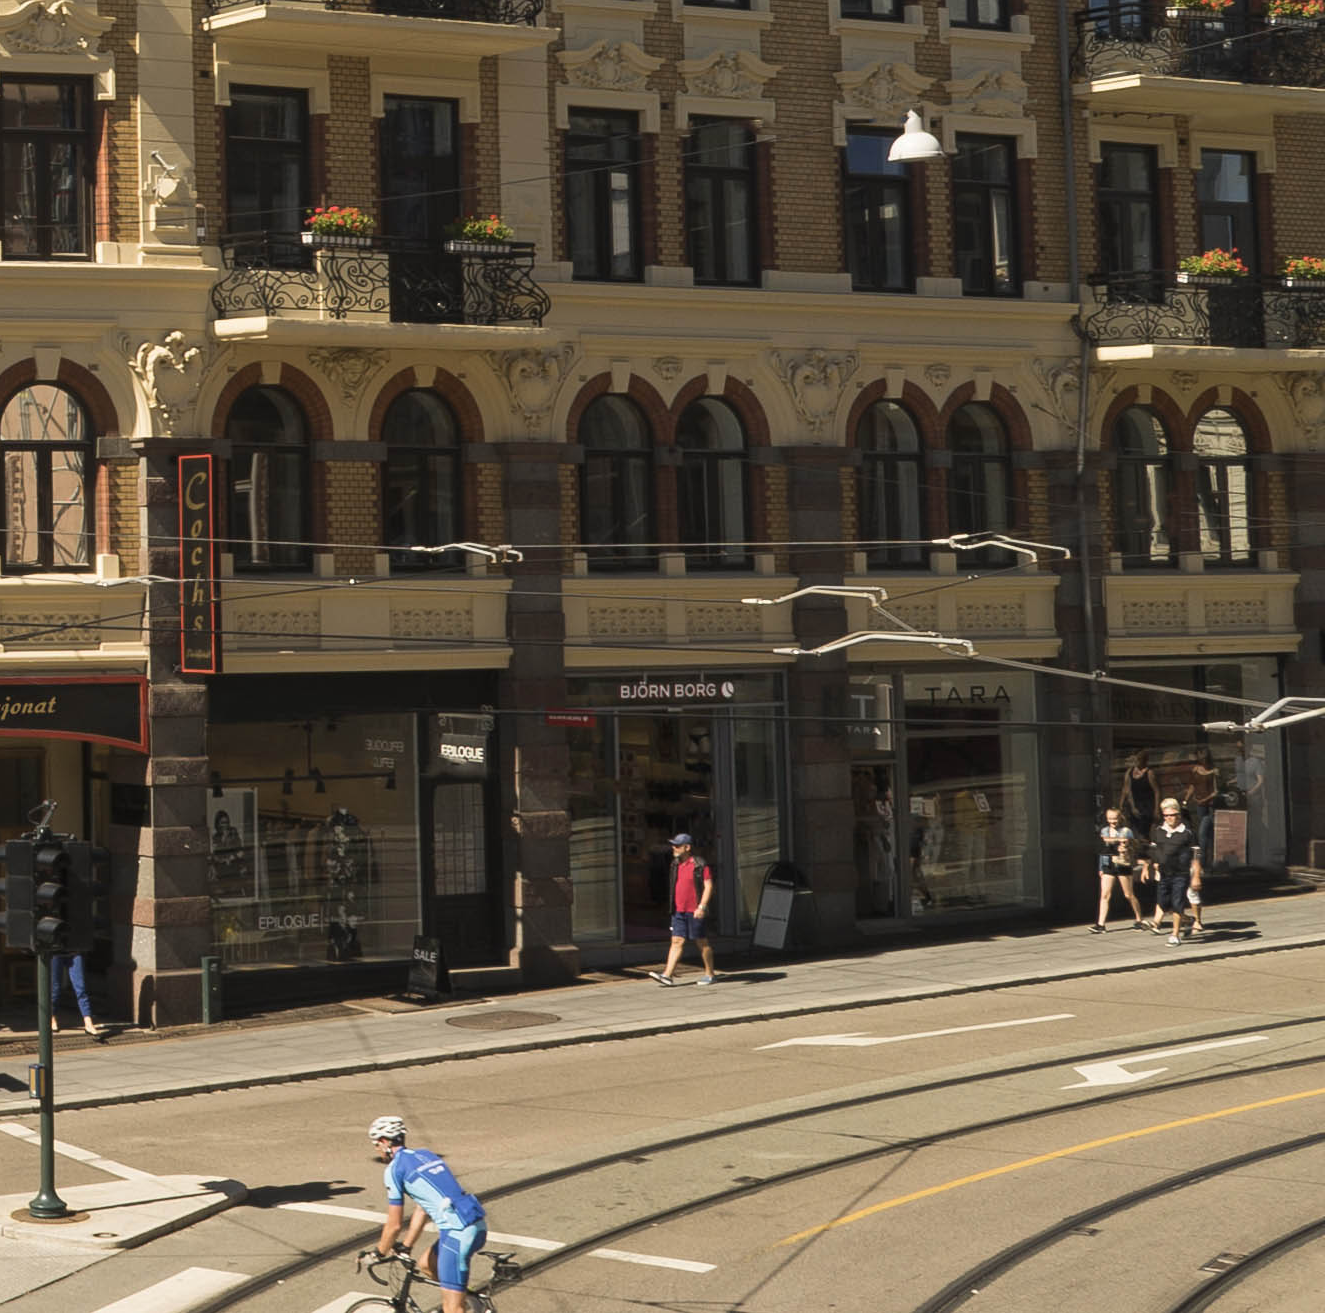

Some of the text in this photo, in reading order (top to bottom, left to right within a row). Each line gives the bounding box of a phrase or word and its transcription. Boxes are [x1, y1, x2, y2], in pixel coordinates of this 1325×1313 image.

[185, 471, 207, 631] Cochs
[620, 682, 716, 699] BJÖRN BORG
[925, 686, 1011, 704] TARA
[258, 913, 320, 930] EPILOGUE
[413, 949, 438, 963] SALE
